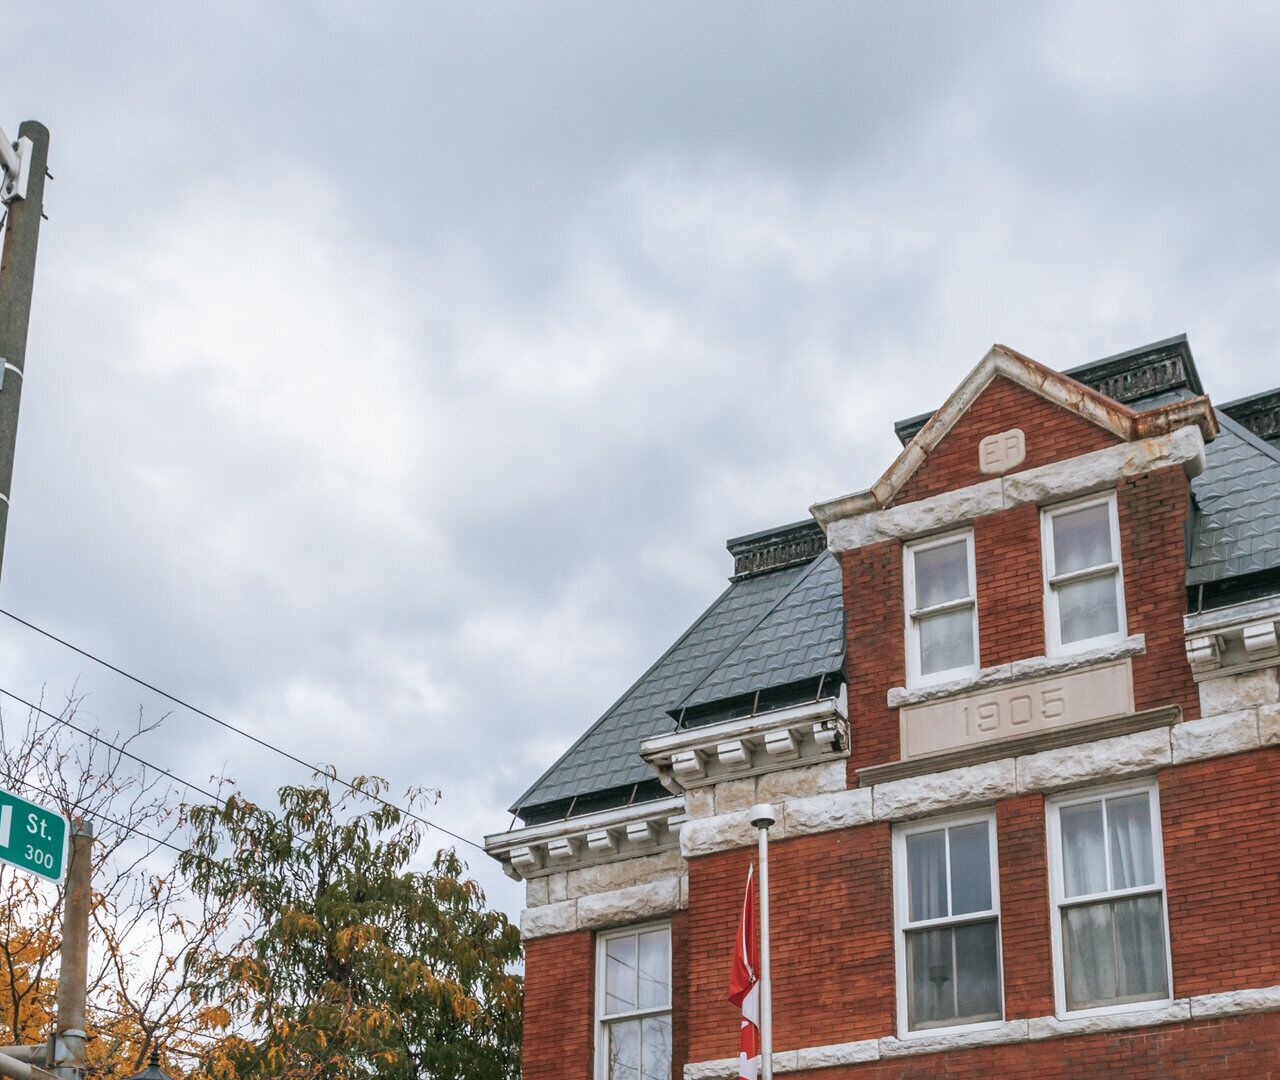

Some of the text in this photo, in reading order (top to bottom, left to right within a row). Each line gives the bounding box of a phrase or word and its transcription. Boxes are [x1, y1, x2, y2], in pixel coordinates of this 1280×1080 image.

[961, 687, 1065, 737] 1905
[26, 813, 52, 841] St.
[24, 845, 54, 870] 300
